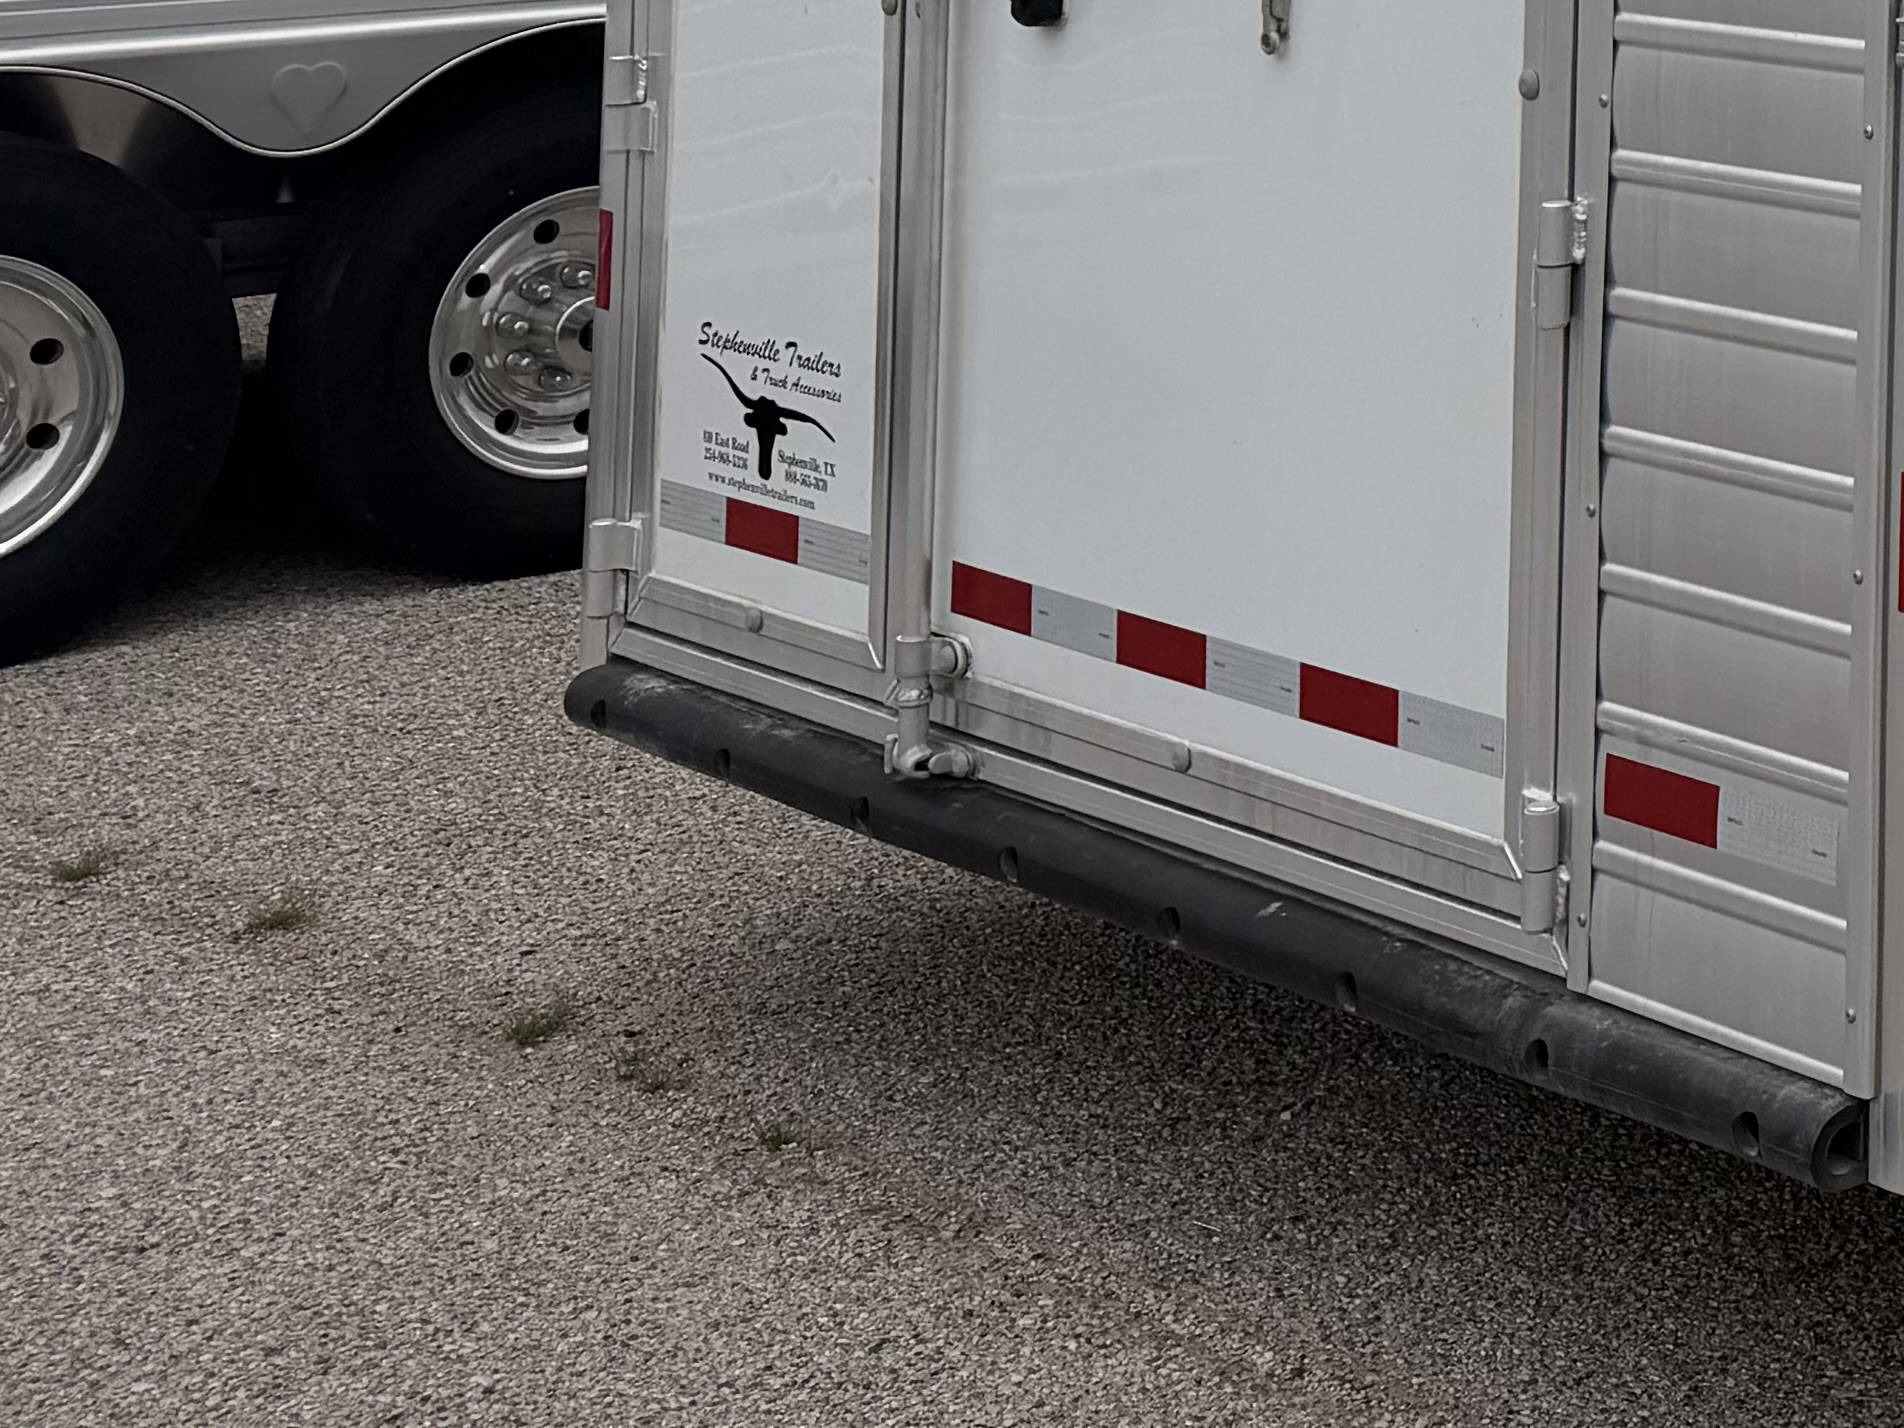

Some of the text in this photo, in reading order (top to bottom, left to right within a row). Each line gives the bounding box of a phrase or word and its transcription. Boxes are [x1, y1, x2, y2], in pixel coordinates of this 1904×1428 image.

[698, 321, 841, 378] Stephenville Trailers
[761, 367, 788, 390] Truck
[789, 376, 841, 403] Accessories
